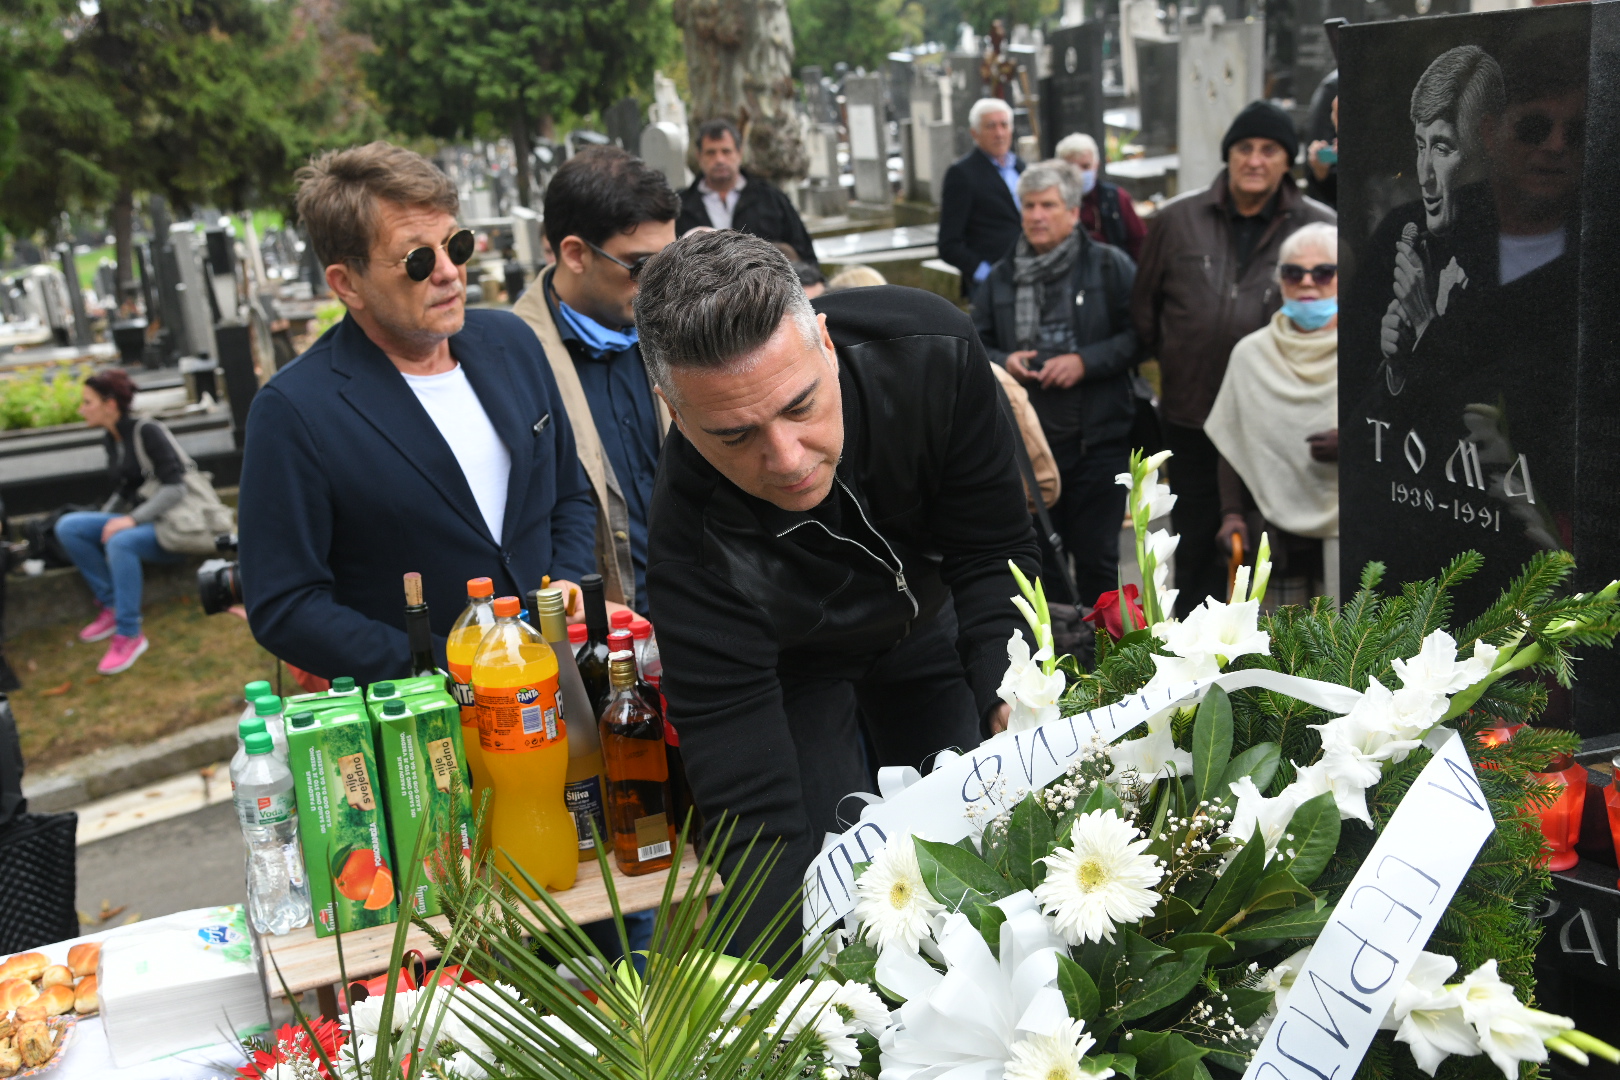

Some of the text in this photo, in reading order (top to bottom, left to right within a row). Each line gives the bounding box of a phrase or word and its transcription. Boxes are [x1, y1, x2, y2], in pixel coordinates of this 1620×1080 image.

[1366, 417, 1535, 504] ТОМА
[1391, 481, 1500, 532] 1938-1991
[515, 687, 539, 702] FANTA
[397, 756, 406, 790] PAKOVANJE
[410, 761, 416, 770] GA
[434, 757, 447, 777] nije
[320, 776, 326, 785] GA
[345, 772, 358, 793] nije
[353, 756, 371, 804] svejedno
[411, 771, 417, 780] DA
[305, 771, 315, 805] PAKOVANJE
[321, 786, 327, 795] DA
[566, 790, 590, 802] Šljiva
[259, 809, 283, 818] Voda
[317, 805, 325, 823] SAMO
[324, 810, 332, 827] KAKO
[368, 821, 382, 867] POMORANDŽA
[460, 822, 470, 849] JABUKA
